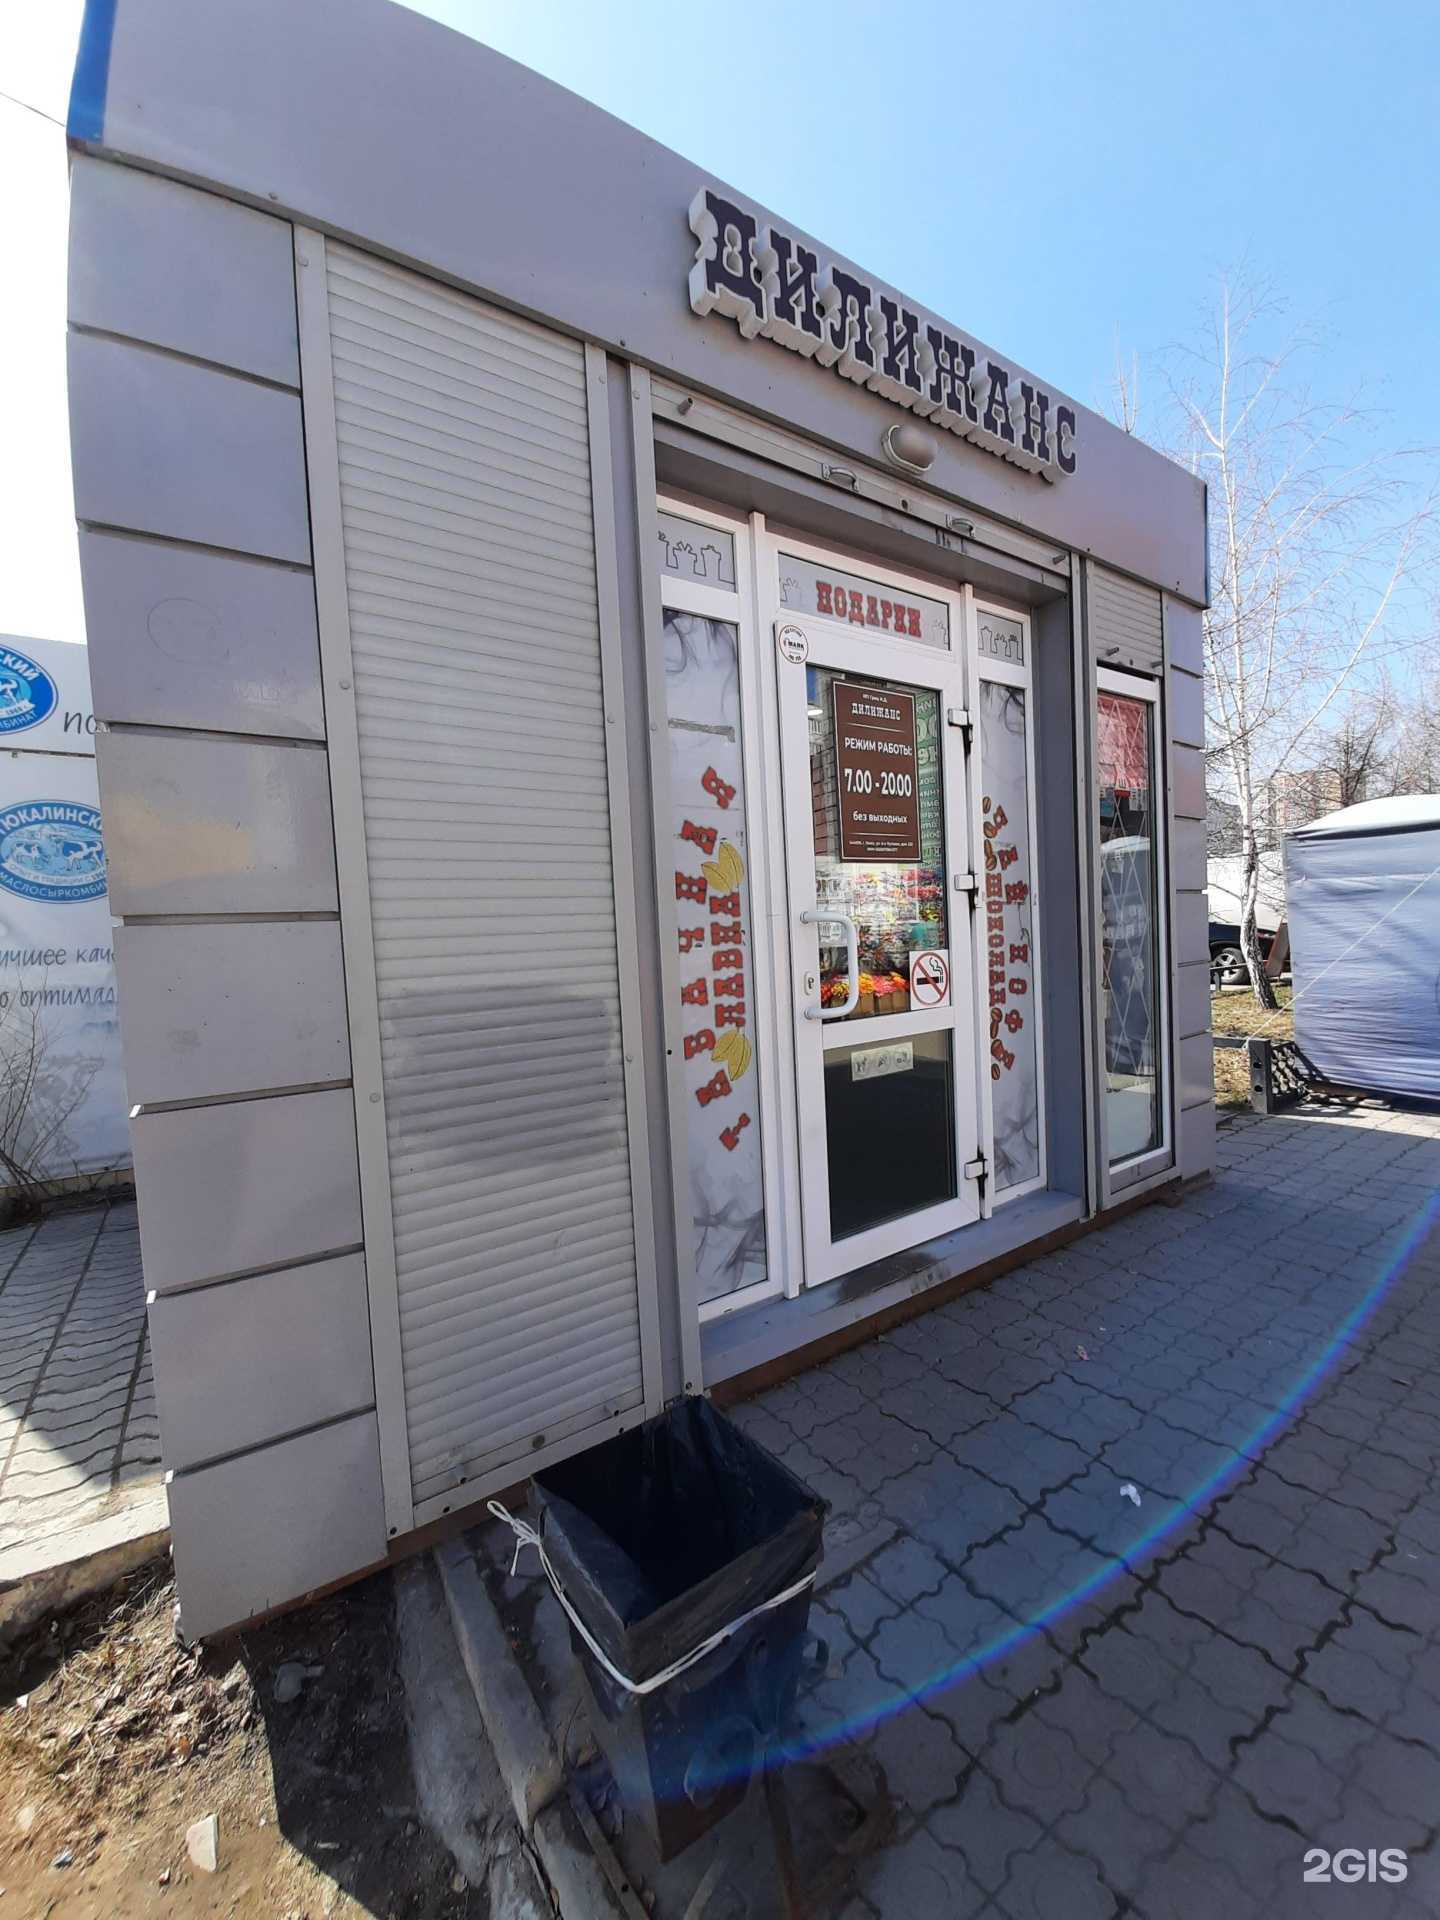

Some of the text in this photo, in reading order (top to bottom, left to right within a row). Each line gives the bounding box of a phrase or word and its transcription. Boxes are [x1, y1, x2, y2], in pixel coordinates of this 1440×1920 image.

[697, 186, 1079, 476] ДИЛИЖАНС
[815, 580, 922, 638] ПОДАРКИ
[851, 702, 901, 721] ДИЛИЖАНС
[844, 736, 876, 751] РЕЖИМ
[877, 741, 913, 756] РАБОТЫ:
[844, 768, 872, 794] 7.00
[880, 771, 912, 797] 20.00
[852, 810, 908, 825] без выходных
[76, 947, 114, 963] кач
[709, 892, 746, 1028] ЛАВКА
[985, 872, 1006, 1008] ШОКОЛАД
[994, 943, 1029, 1071] КОФЕ
